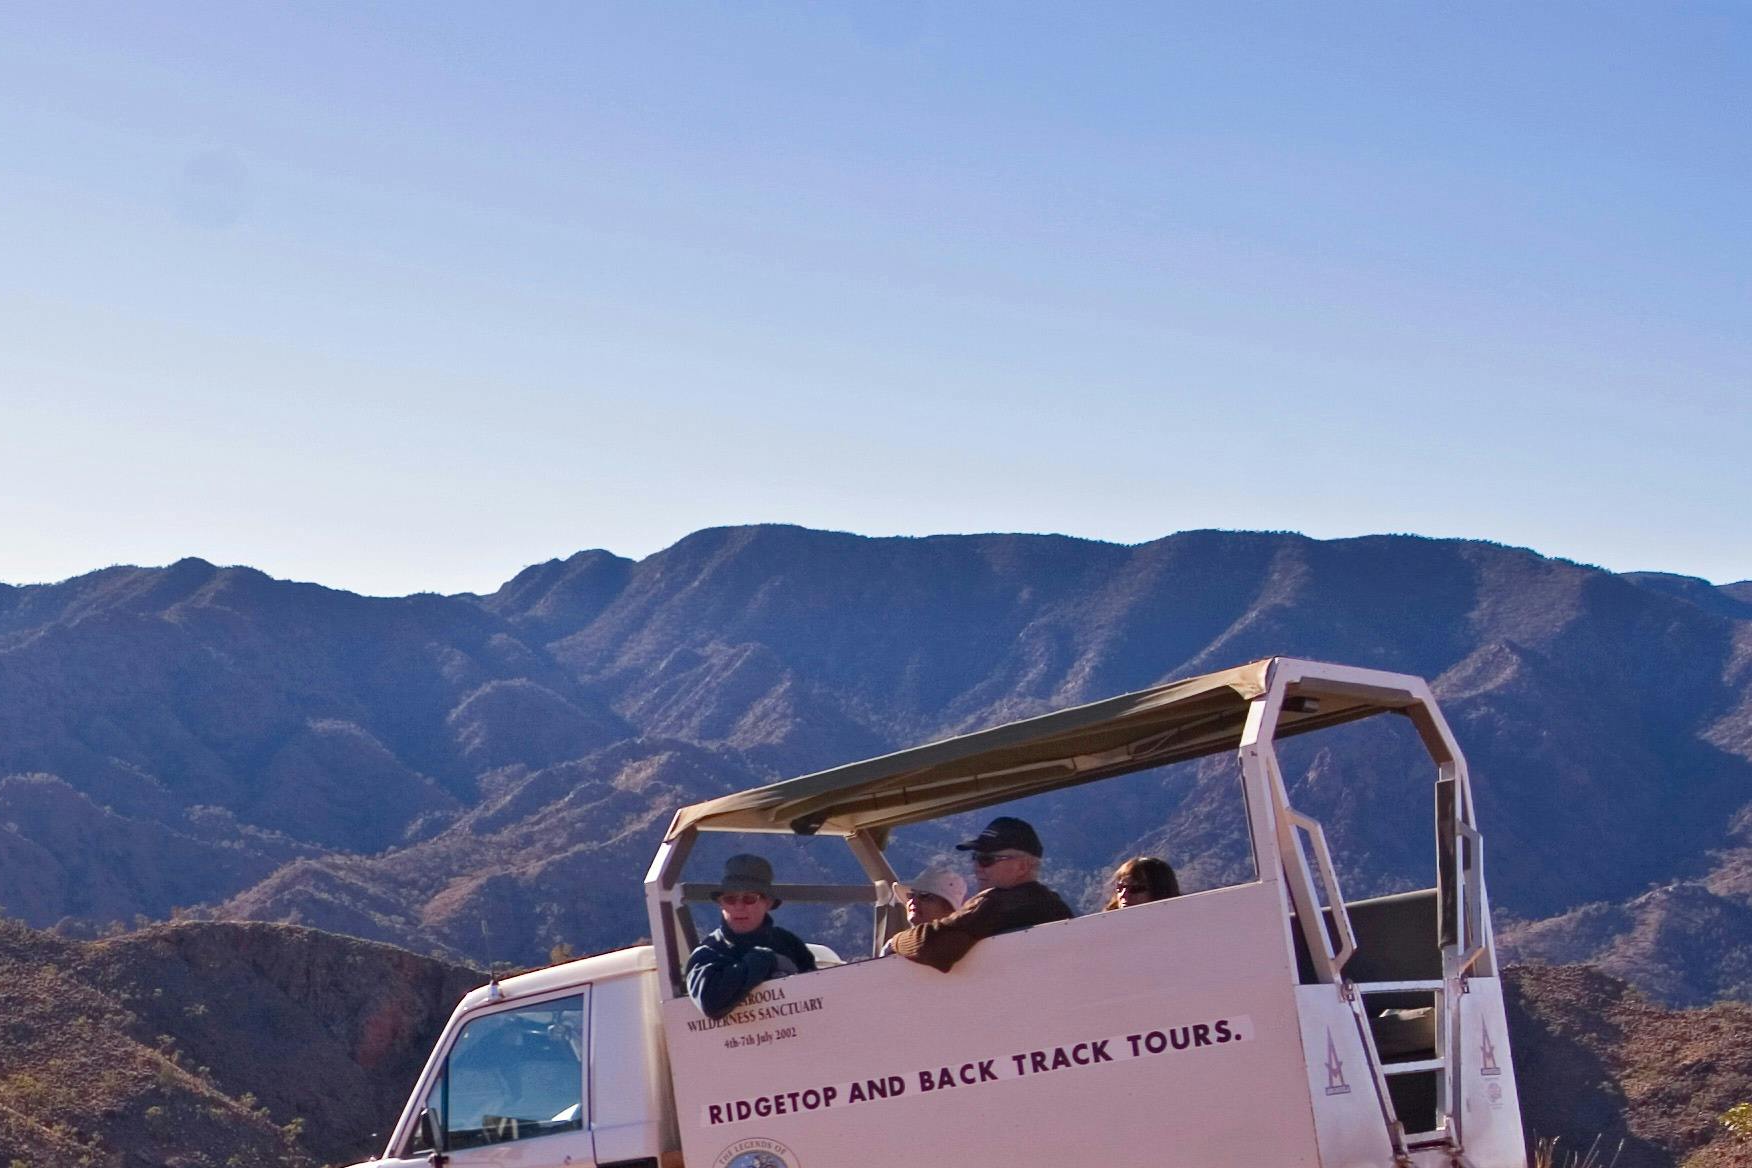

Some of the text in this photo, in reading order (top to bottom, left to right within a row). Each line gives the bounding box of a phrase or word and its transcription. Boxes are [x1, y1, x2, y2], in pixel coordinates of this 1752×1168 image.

[687, 997, 824, 1032] WILDERNESS SANCTUARY
[724, 1027, 797, 1049] 4th-7th July 2002
[709, 1020, 1242, 1125] RIDGETOP AND BACK TRACK TOURS.
